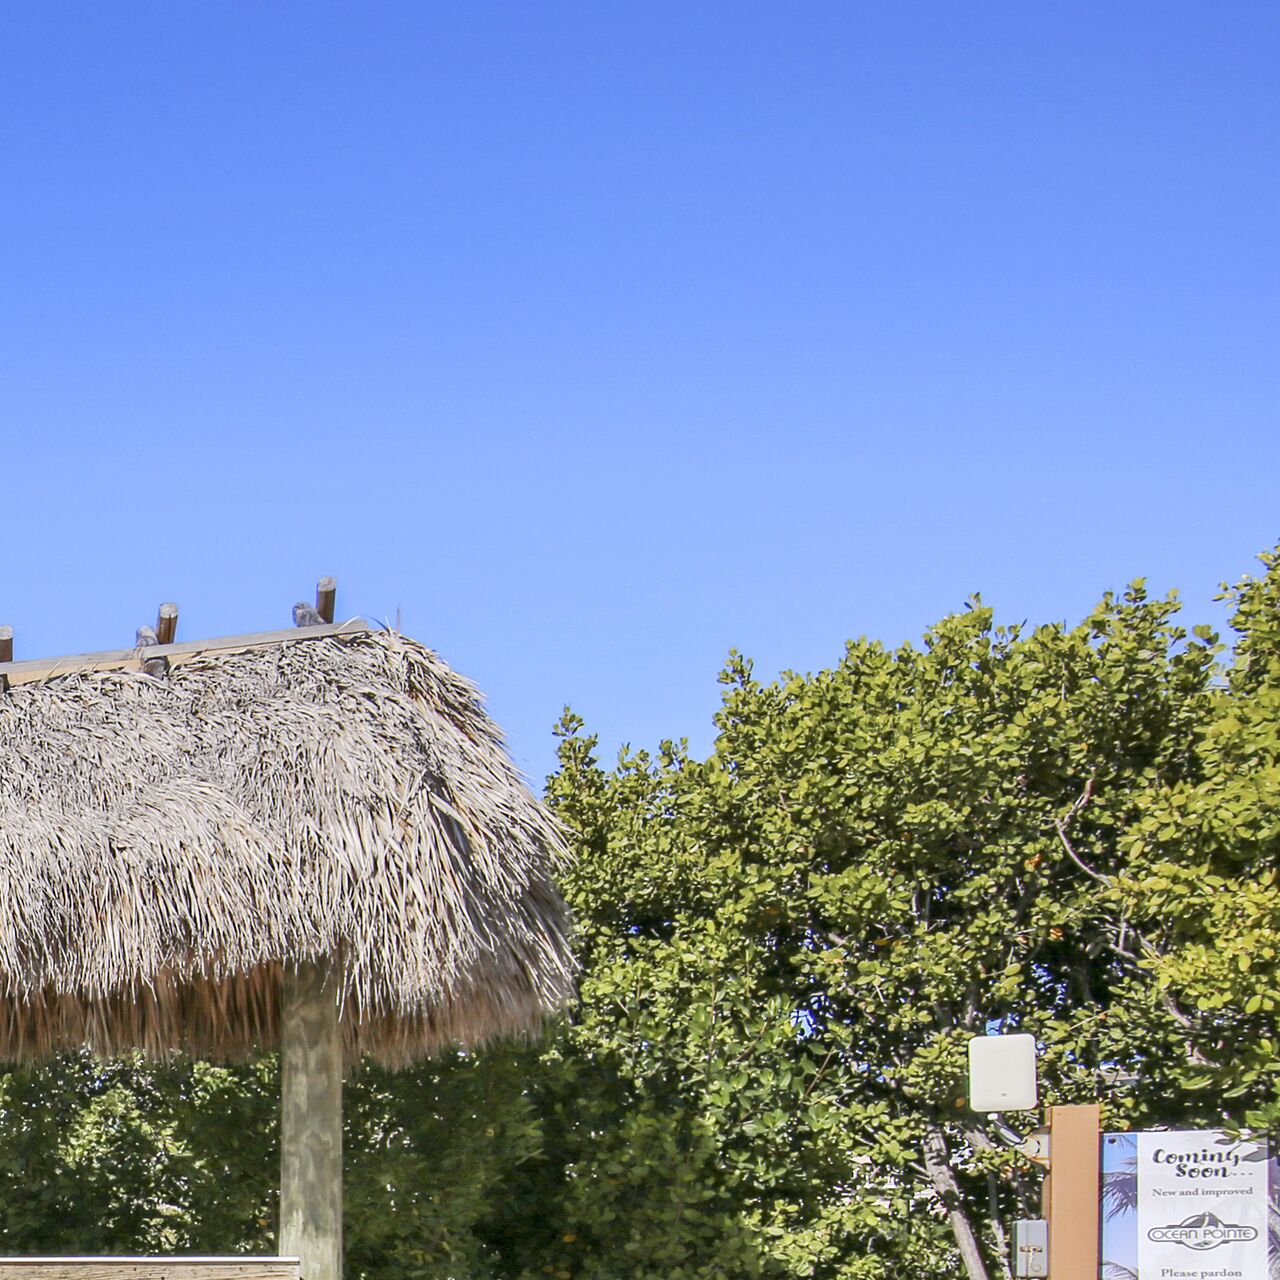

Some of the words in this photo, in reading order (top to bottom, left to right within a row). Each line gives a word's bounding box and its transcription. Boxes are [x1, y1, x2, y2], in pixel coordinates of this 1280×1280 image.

[1152, 1149, 1241, 1167] Coming
[1152, 1188, 1177, 1197] New
[1178, 1187, 1199, 1197] and
[1201, 1187, 1253, 1197] improved
[1151, 1229, 1199, 1240] OCEAN
[1203, 1228, 1252, 1239] POINTE
[1160, 1268, 1198, 1277] Please
[1201, 1268, 1242, 1279] pardon
